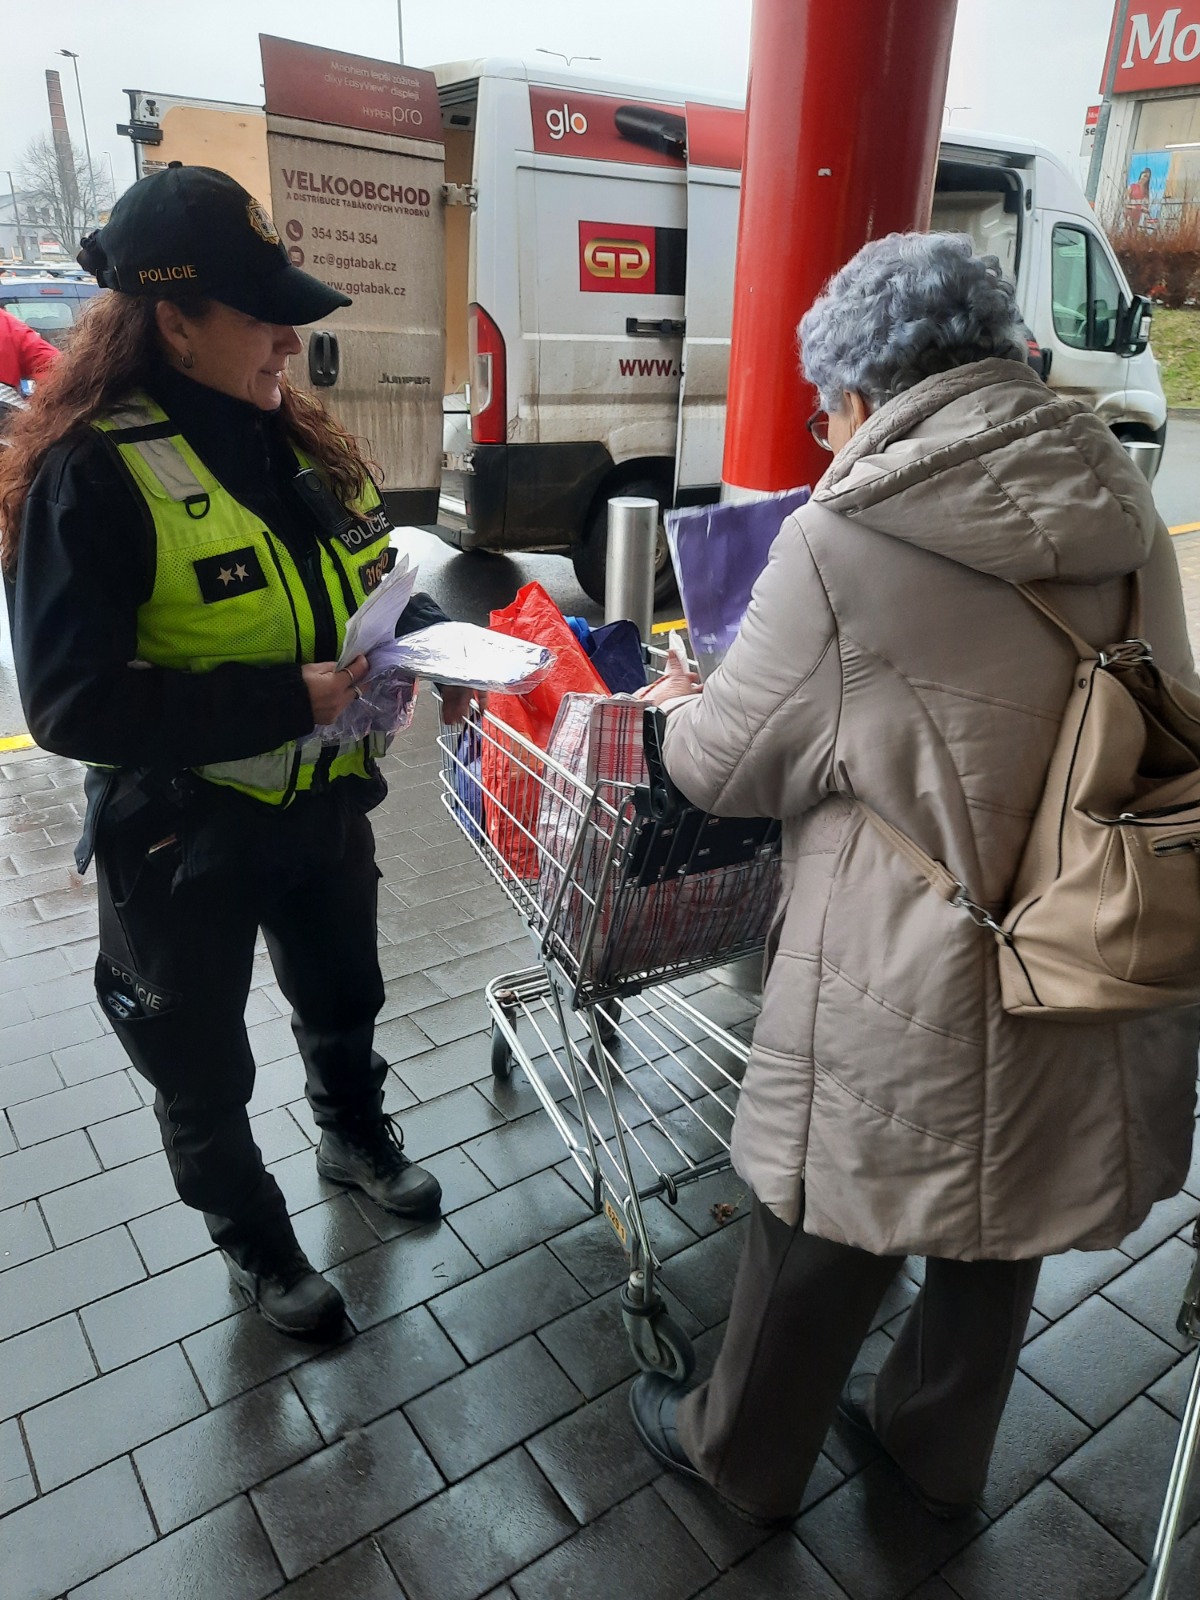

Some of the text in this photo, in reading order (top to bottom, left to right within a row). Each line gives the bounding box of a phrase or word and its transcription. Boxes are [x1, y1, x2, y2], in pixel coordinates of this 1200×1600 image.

[392, 106, 423, 126] pro
[546, 103, 588, 140] glo
[281, 168, 431, 206] VELKOOBCHOD
[286, 191, 292, 200] A
[293, 193, 341, 207] DISTRIBUCE
[311, 226, 378, 245] 354 354 354
[313, 253, 397, 271] zc@ggtabak.cz
[139, 264, 198, 285] POLICIE
[323, 281, 406, 296] ww.ggtabak.cz
[619, 358, 684, 377] www.
[340, 511, 390, 549] POLICIE
[111, 966, 163, 1010] POICIE
